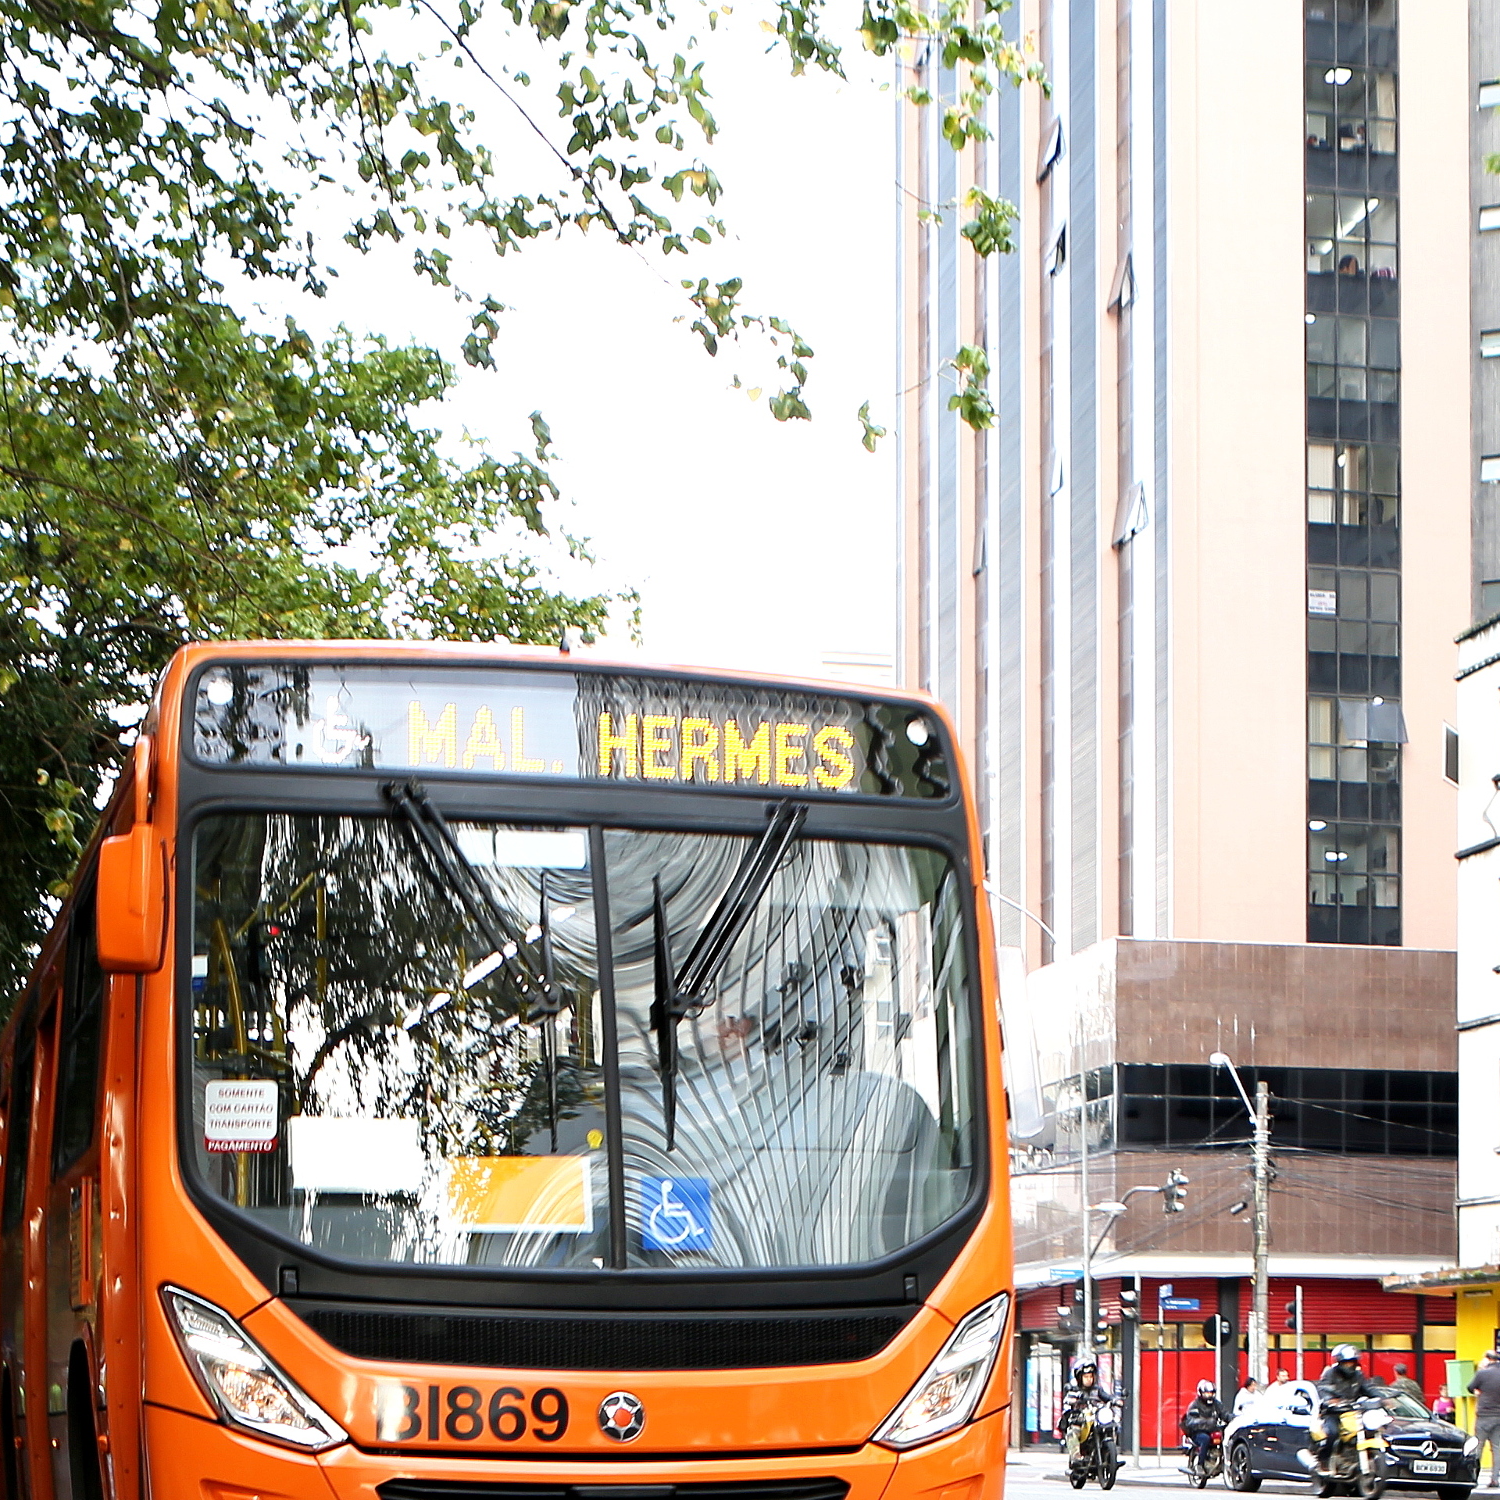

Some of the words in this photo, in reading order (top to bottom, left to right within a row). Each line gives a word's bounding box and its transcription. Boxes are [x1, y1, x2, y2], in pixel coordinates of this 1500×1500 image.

[407, 701, 564, 774] MAL.
[598, 711, 856, 789] HERMES
[218, 1087, 265, 1099] SOMENTE
[209, 1103, 232, 1114] COM
[233, 1102, 274, 1114] CARTÃO
[209, 1118, 273, 1130] TRANSPORTE
[207, 1140, 273, 1151] PAGAMENTO
